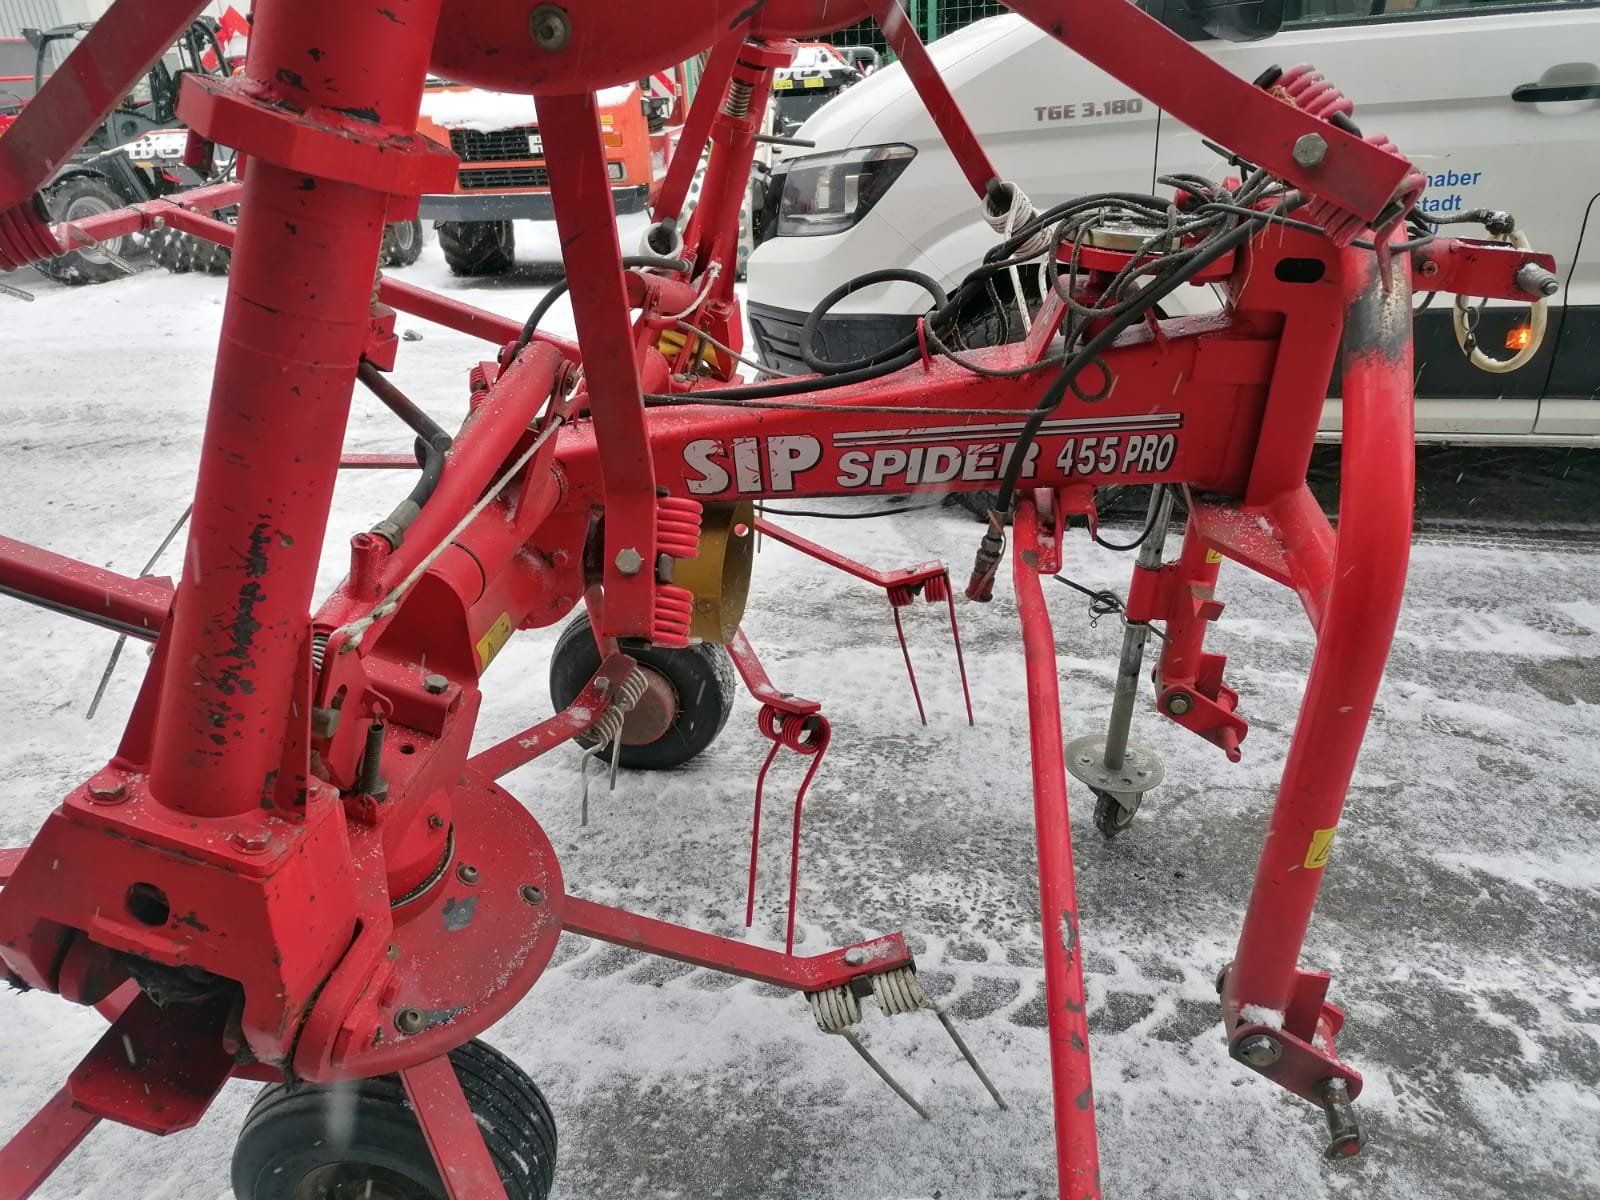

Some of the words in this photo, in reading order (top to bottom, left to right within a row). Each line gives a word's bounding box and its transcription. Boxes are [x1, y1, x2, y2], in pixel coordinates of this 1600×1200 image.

[1034, 104, 1076, 121] TGE
[1081, 98, 1143, 118] 3.180
[683, 434, 821, 495] SIP
[836, 441, 1040, 488] SPIDER
[1056, 436, 1119, 475] 455
[1121, 433, 1176, 473] PRO
